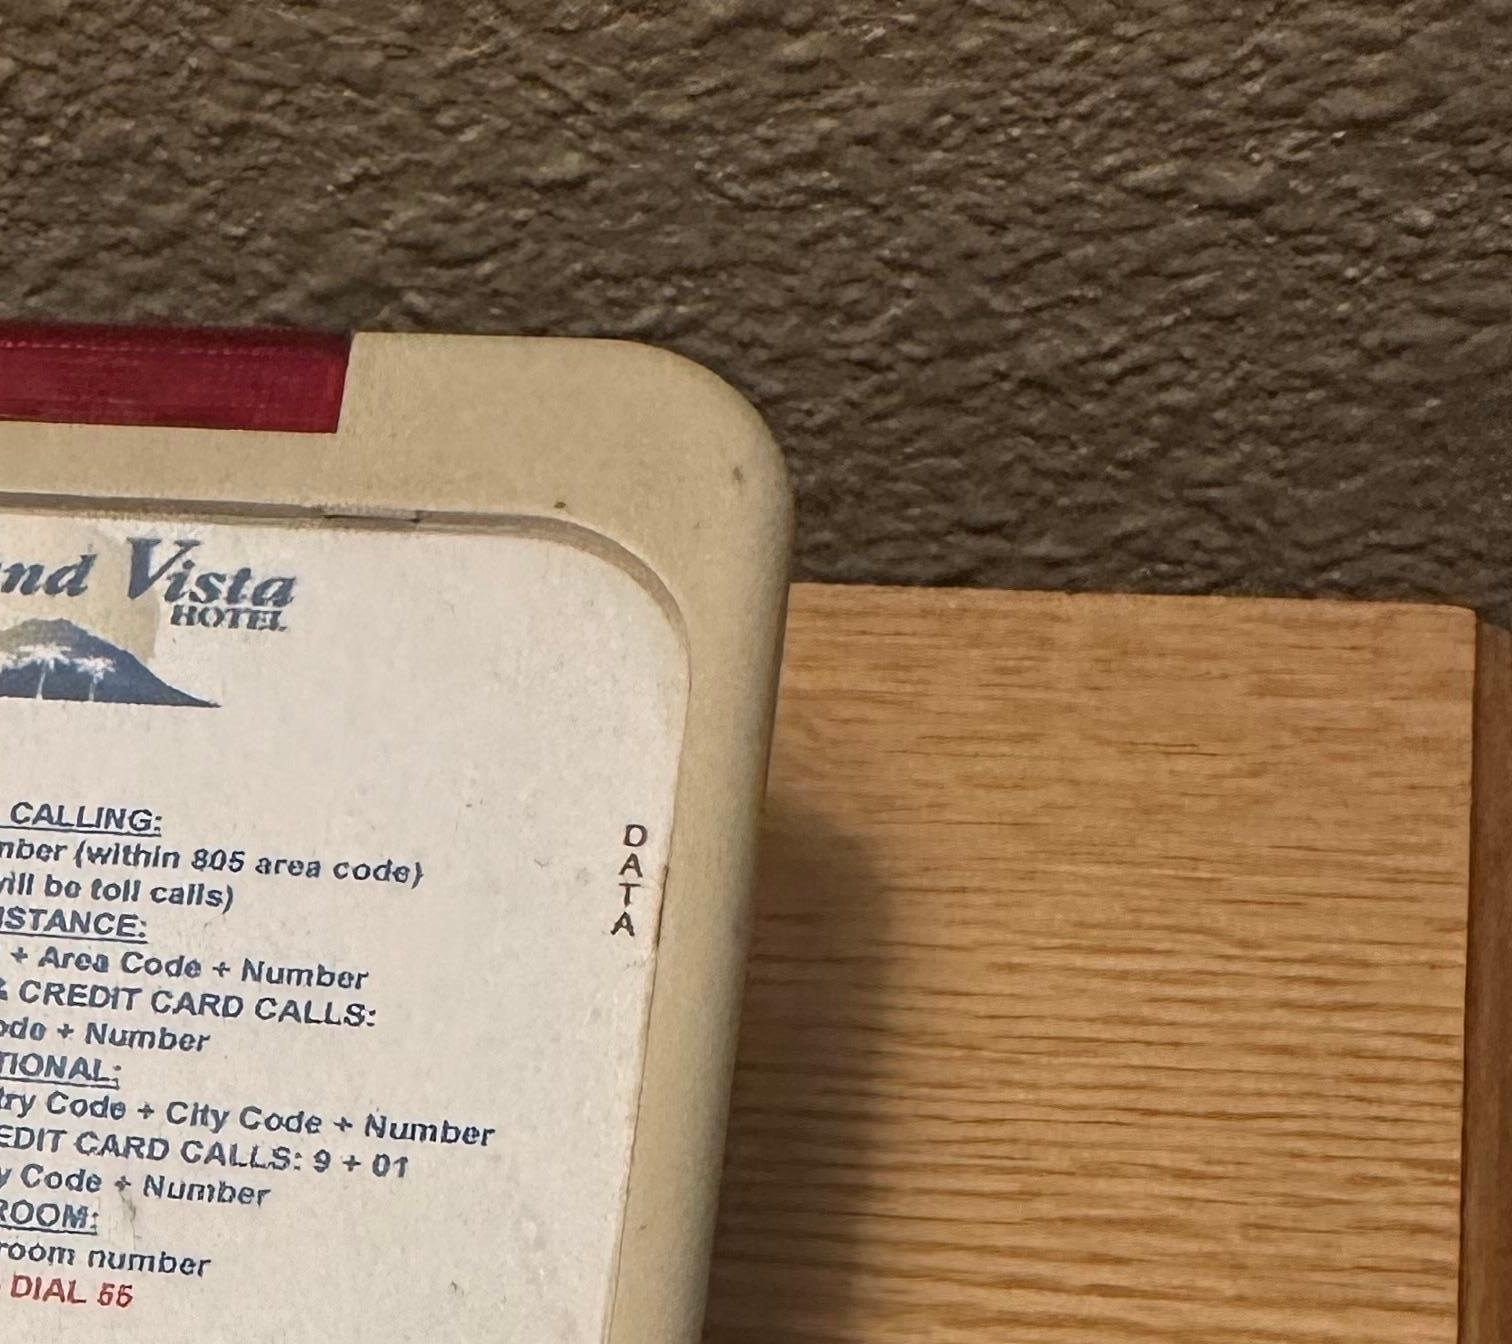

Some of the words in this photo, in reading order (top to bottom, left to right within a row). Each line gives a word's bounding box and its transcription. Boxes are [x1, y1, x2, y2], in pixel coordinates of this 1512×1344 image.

[126, 537, 297, 607] Vista
[170, 604, 287, 631] HOTEL
[10, 802, 162, 836] CALLING:
[74, 839, 181, 871] (within
[190, 849, 246, 873] 805
[255, 856, 322, 880] area
[333, 859, 424, 888] code)
[610, 824, 648, 936] DATA
[44, 875, 82, 898] be
[90, 878, 140, 902] toll
[150, 883, 234, 914] calls)
[10, 946, 29, 963] +
[38, 946, 109, 974] Area
[121, 951, 202, 978] Code
[212, 960, 231, 978] +
[241, 959, 369, 990] Number
[18, 979, 143, 1011] CREDIT
[150, 989, 245, 1018] CARD
[254, 997, 377, 1028] CALLS:
[56, 1022, 75, 1040] +
[85, 1022, 210, 1052] Number
[46, 1090, 126, 1121] Code
[137, 1103, 156, 1120] +
[166, 1101, 229, 1133] City
[239, 1105, 322, 1134] Code
[333, 1116, 353, 1133] +
[364, 1114, 497, 1147] Number
[74, 1130, 170, 1161] CARD
[180, 1139, 302, 1171] CALLS:
[312, 1150, 332, 1173] 9
[341, 1155, 361, 1173] +
[372, 1154, 408, 1178] 01
[19, 1162, 102, 1193] Code
[113, 1175, 132, 1192] +
[142, 1174, 271, 1207] Number
[87, 1247, 211, 1277] number
[9, 1274, 86, 1305] DIAL
